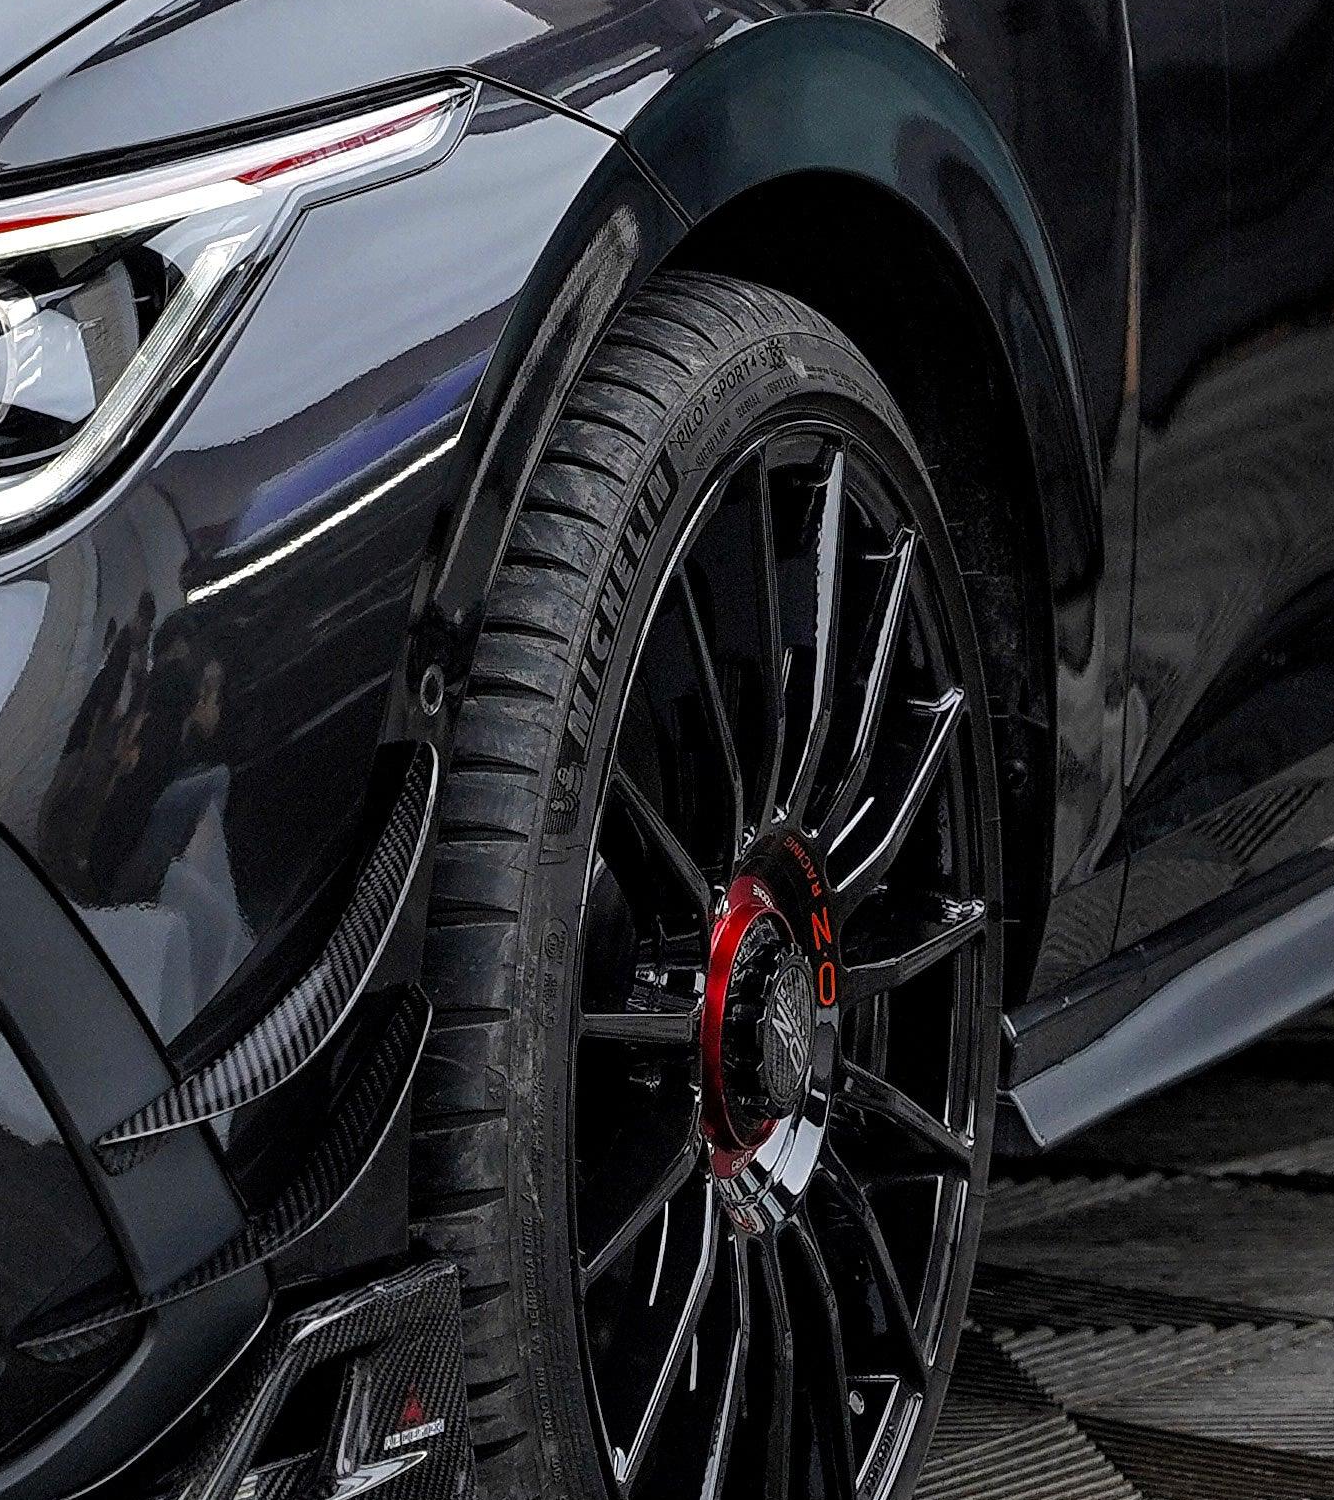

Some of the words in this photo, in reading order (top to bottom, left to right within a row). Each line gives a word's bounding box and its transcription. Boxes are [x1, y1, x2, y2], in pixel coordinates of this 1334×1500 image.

[669, 396, 709, 451] PILOT
[712, 358, 751, 404] SPORT
[567, 462, 672, 748] MICHELIN
[784, 835, 823, 898] RACING
